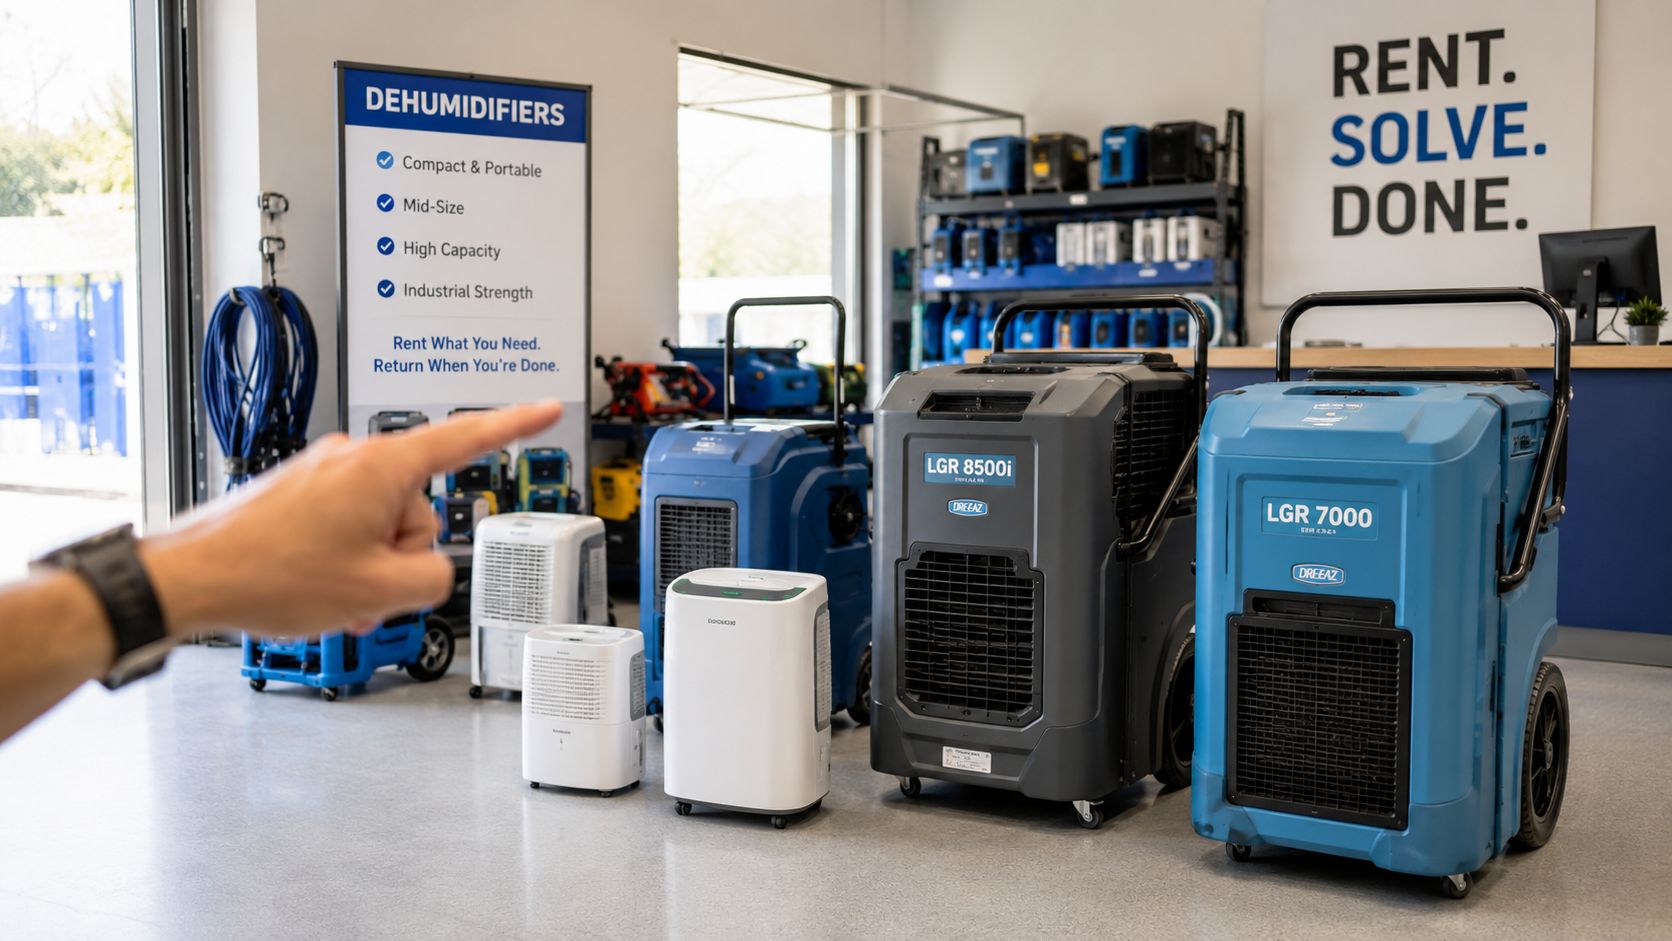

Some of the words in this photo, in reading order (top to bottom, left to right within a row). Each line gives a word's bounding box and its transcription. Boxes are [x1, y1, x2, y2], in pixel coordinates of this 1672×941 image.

[1333, 28, 1517, 98] RENT.
[365, 85, 565, 126] DEHUMIDIFIERS
[1330, 101, 1547, 168] SOLVE.
[402, 155, 466, 175] Compact
[470, 159, 481, 174] &
[485, 160, 542, 178] Portable
[403, 197, 465, 215] Mid-Size
[1332, 176, 1528, 237] DONE.
[404, 240, 437, 259] High
[440, 242, 501, 262] Capacity
[404, 283, 471, 299] Industrial
[474, 284, 533, 303] Strength
[393, 335, 427, 350] Rent
[430, 336, 469, 350] What
[472, 336, 498, 351] You
[502, 336, 541, 351] Need.
[374, 358, 424, 373] Return
[427, 358, 469, 373] When
[472, 358, 517, 373] You're
[520, 358, 560, 372] Done.
[927, 457, 959, 475] LGR
[963, 458, 1012, 477] 8500i
[1267, 502, 1310, 524] LGR
[1315, 505, 1373, 529] 7000
